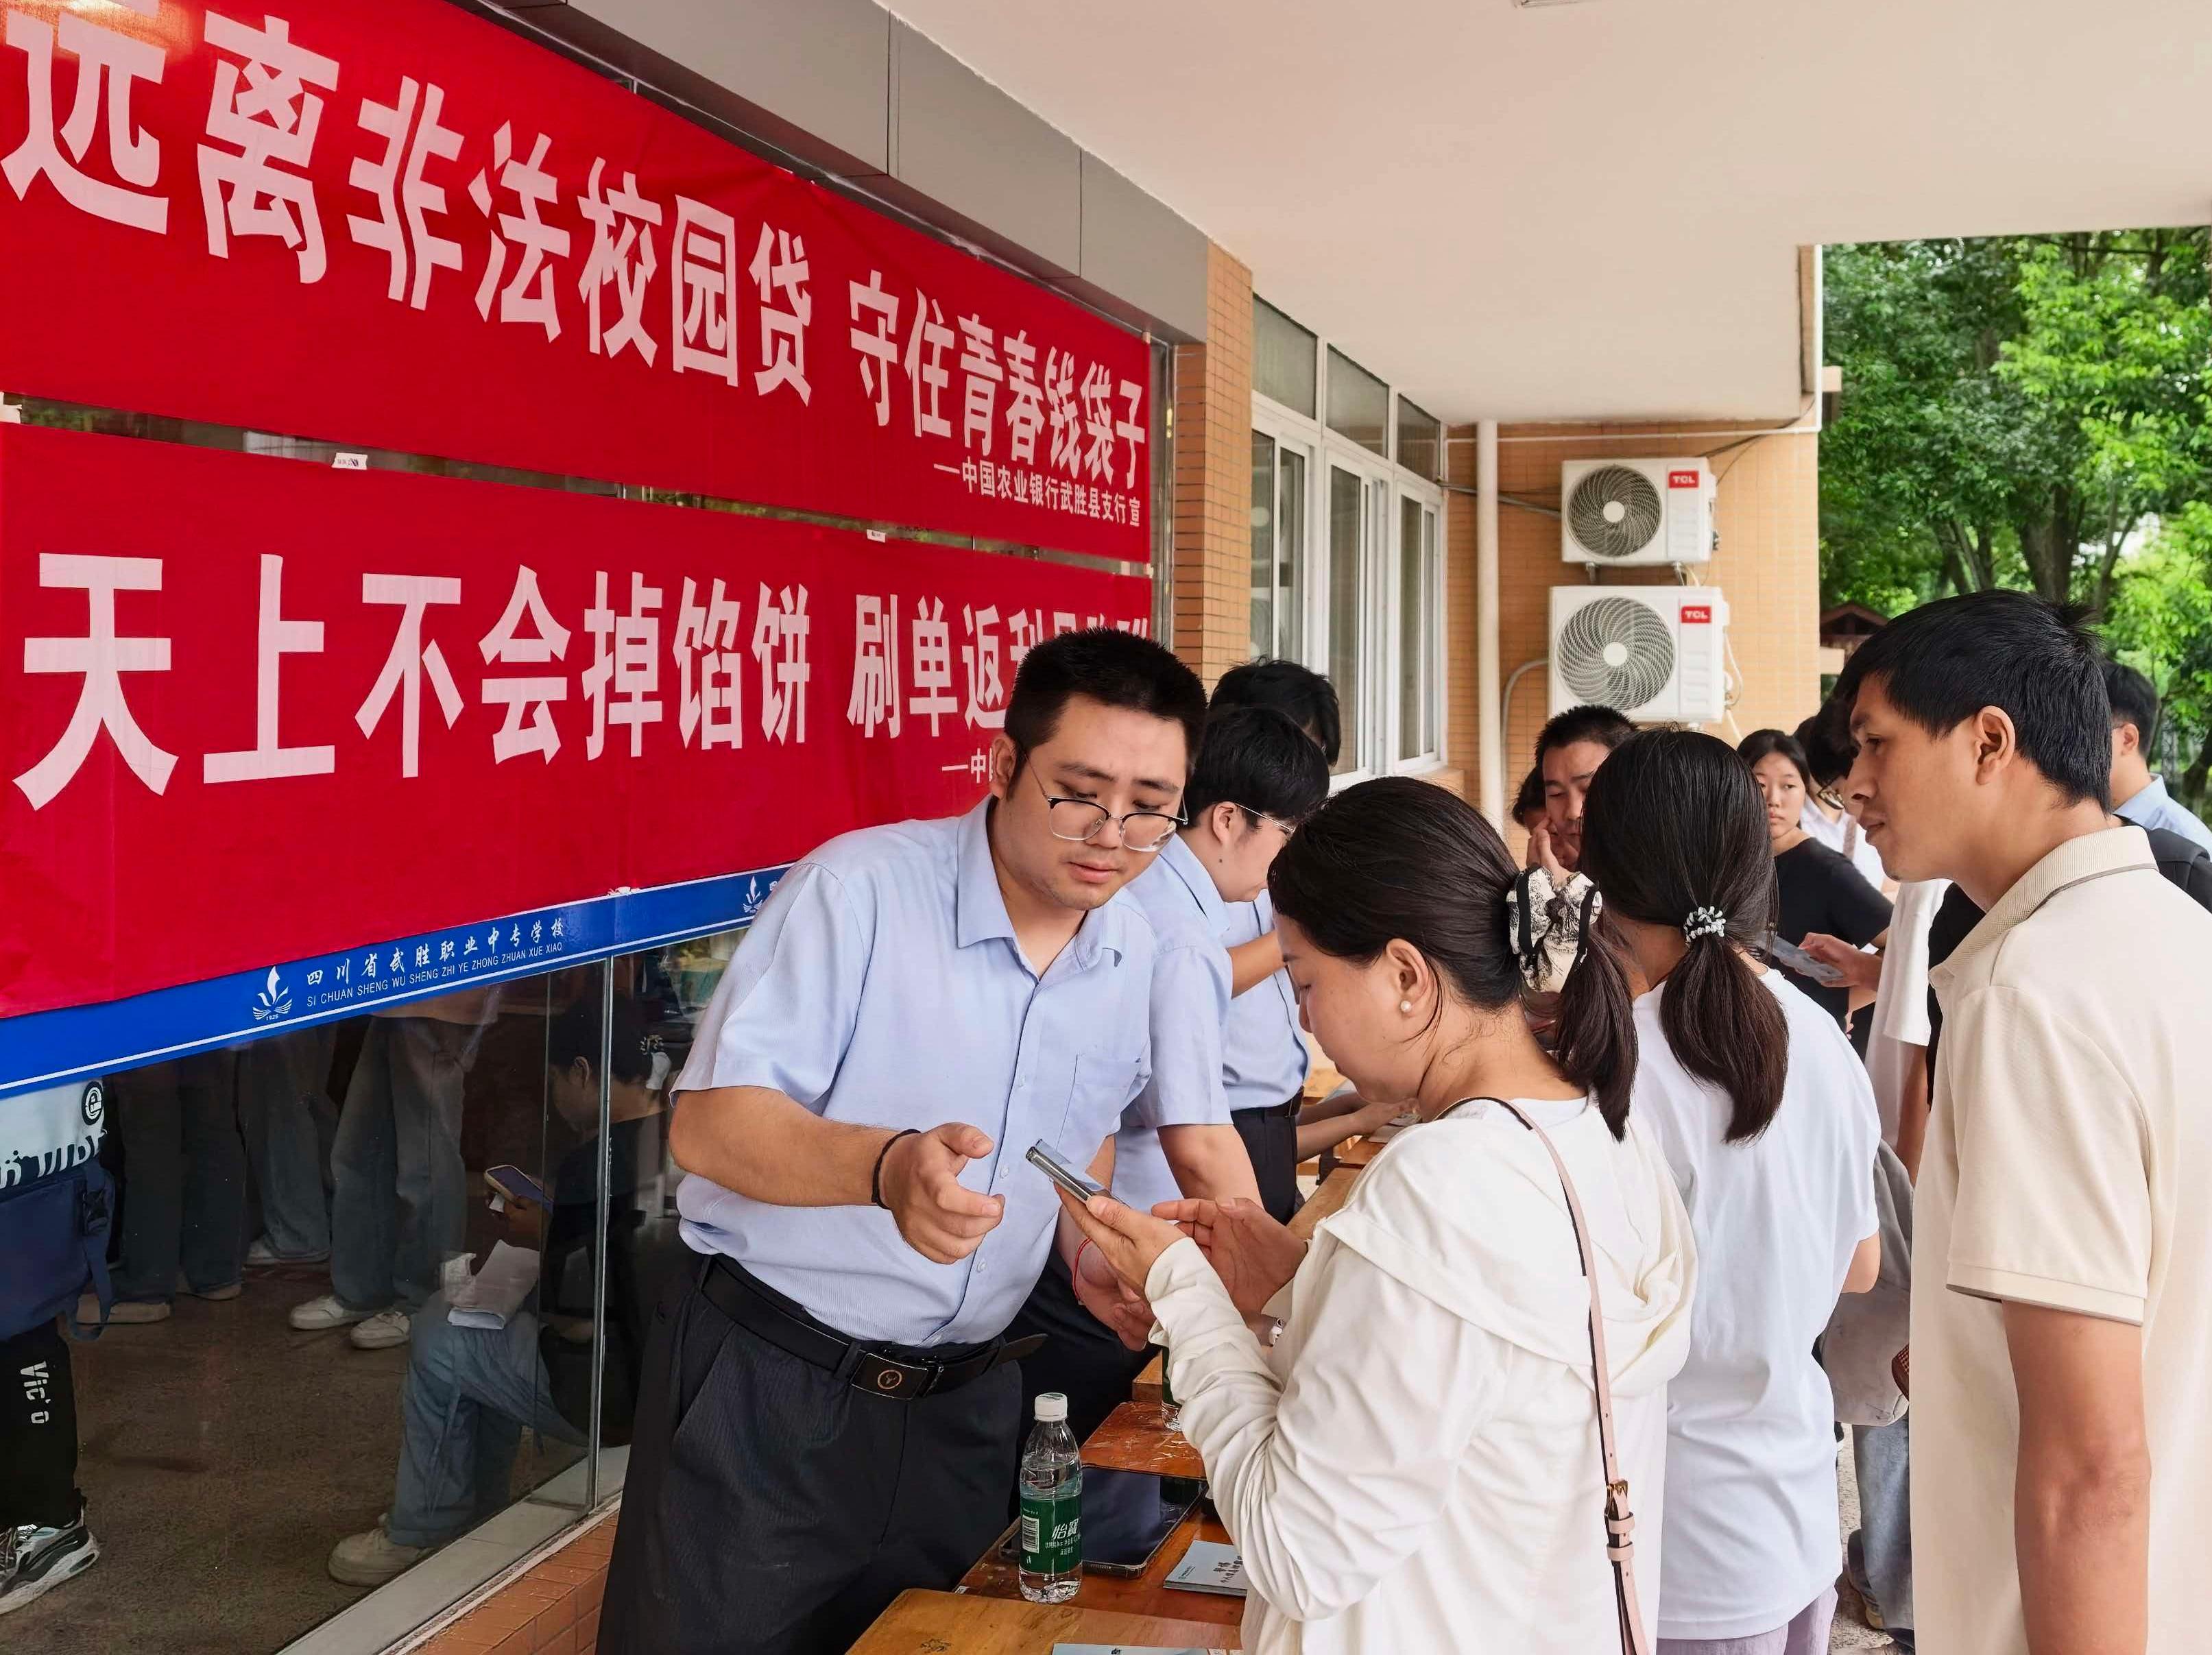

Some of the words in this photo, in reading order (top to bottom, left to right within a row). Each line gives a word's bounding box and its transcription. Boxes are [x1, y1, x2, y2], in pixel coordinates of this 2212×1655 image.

[1, 0, 811, 407] 远离非法校园贷
[849, 269, 1146, 490] 守住青春钱袋子
[1673, 475, 1696, 484] TCL
[1685, 610, 1709, 620] TCL
[12, 552, 810, 812] 天上不会掉馅饼
[306, 917, 564, 985] 四川省武胜职业中专学校
[306, 995, 316, 1007] SI
[320, 987, 353, 1004] CHUAN
[357, 980, 388, 995] SHENG
[392, 976, 406, 987] WU
[409, 968, 439, 984] SHENG
[442, 965, 455, 977] ZHI
[458, 961, 469, 974] YE
[471, 955, 498, 971] ZHONG
[501, 949, 526, 964] ZHUAN
[529, 945, 543, 956] XUE
[546, 941, 563, 953] XIAO
